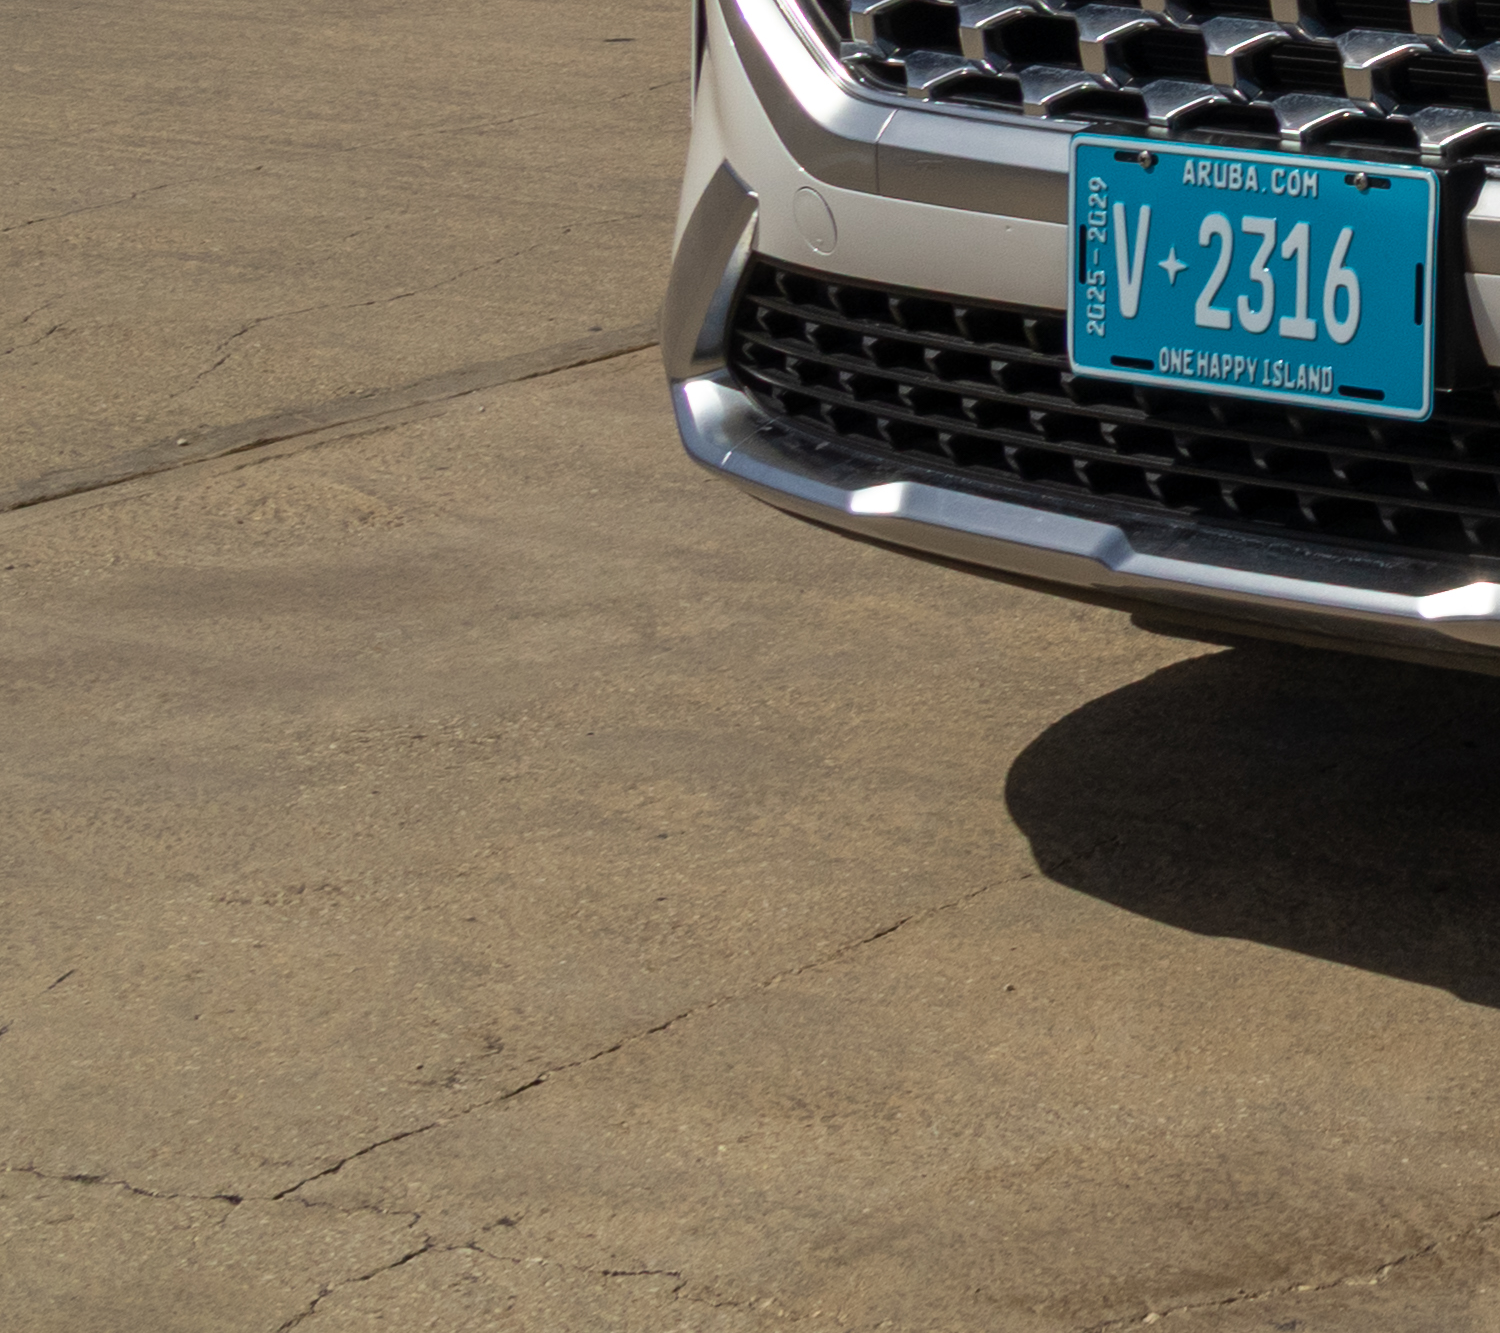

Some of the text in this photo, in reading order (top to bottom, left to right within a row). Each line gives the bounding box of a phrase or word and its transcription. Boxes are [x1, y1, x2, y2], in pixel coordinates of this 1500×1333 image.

[1182, 159, 1319, 199] ARUBA.COM
[1112, 201, 1361, 345] V 2316
[1158, 346, 1334, 395] ONE HAPPY ISLAND
